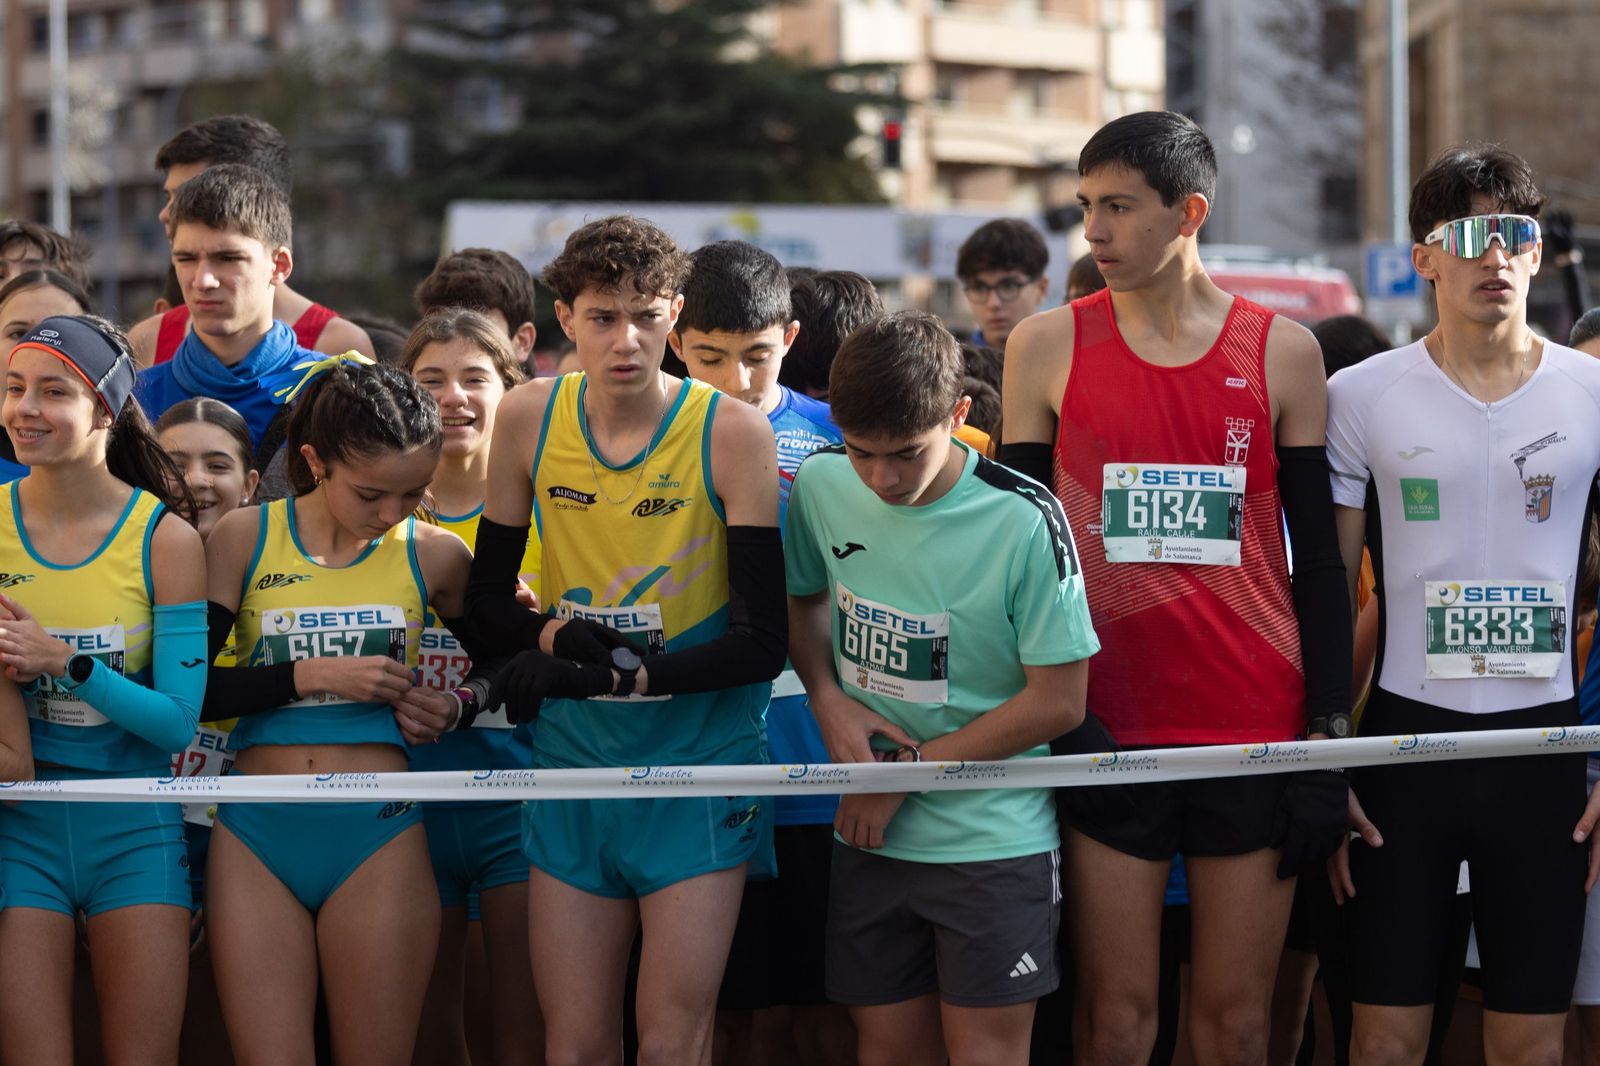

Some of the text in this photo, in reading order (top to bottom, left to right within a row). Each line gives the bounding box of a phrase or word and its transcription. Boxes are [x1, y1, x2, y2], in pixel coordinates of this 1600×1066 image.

[1376, 257, 1409, 292] P
[648, 480, 680, 489] amura
[1142, 470, 1232, 488] SETEL
[554, 487, 588, 503] ALJOMAR
[1128, 490, 1207, 531] 6134
[1167, 530, 1196, 538] CALLE
[1165, 545, 1202, 554] Ayuntamiento
[1464, 587, 1553, 602] SETEL
[300, 610, 392, 628] SETEL
[854, 603, 935, 634] SETEL
[1444, 608, 1534, 646] 6333
[50, 634, 111, 650] TEL
[288, 630, 366, 657] 6157
[420, 634, 457, 650] SE
[844, 616, 908, 672] 6165
[1488, 660, 1526, 668] Ayuntamiento
[870, 677, 904, 691] Ayuntamiento
[878, 686, 904, 698] Salamanca
[50, 708, 84, 716] Ayuntamiento
[58, 715, 84, 724] Salamanca
[1548, 727, 1600, 742] Silvestr
[196, 732, 231, 754] EL
